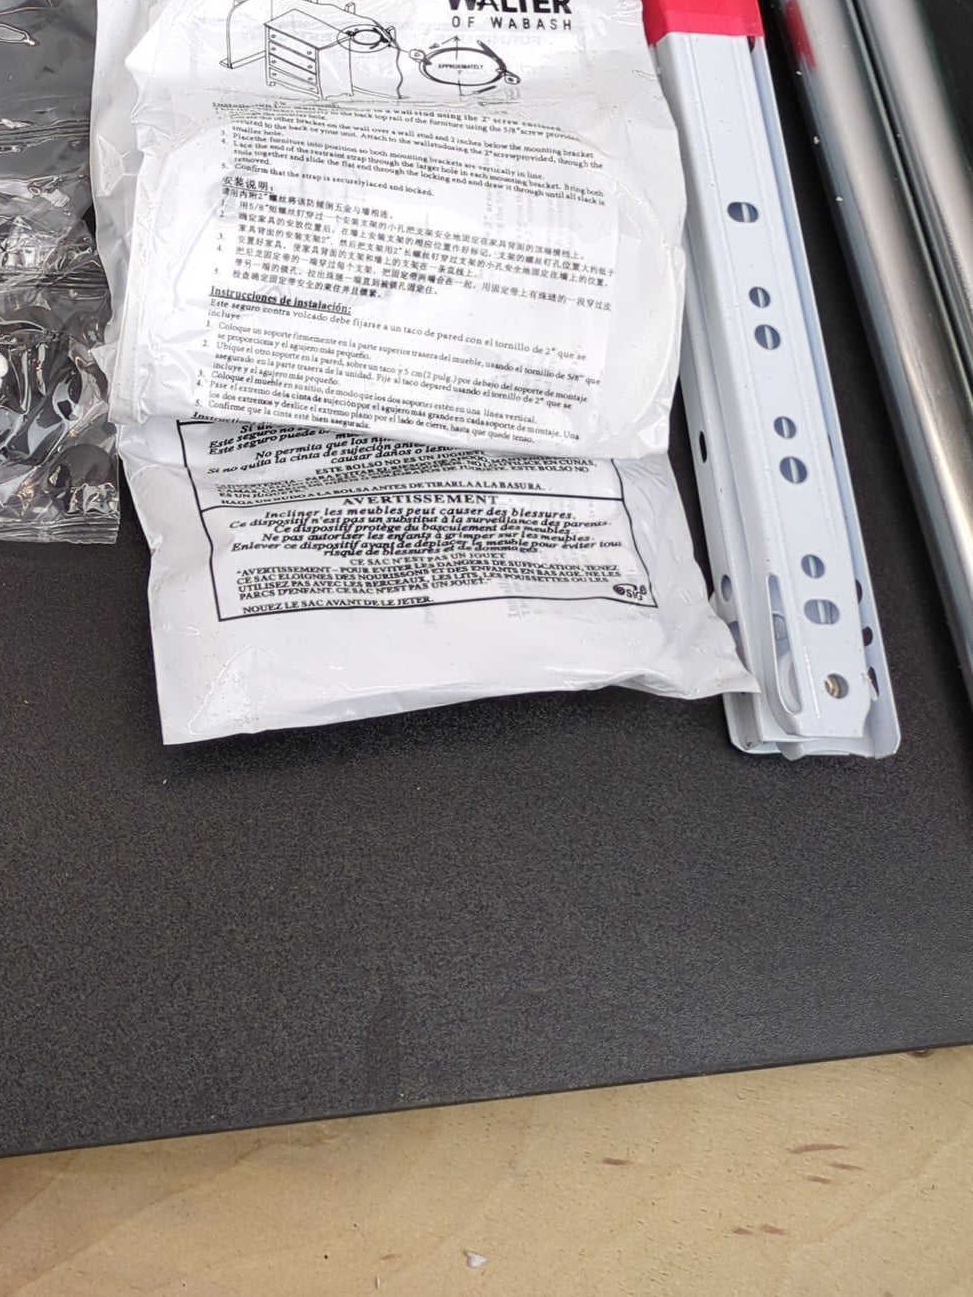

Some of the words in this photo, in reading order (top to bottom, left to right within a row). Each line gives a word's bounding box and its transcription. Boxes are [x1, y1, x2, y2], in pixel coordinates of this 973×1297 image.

[451, 16, 475, 28] OF
[491, 17, 572, 30] WABASH
[296, 145, 309, 154] the
[368, 154, 399, 167] through
[401, 159, 414, 168] the
[369, 147, 387, 157] both
[389, 152, 427, 164] mounting
[269, 166, 285, 176] that
[286, 169, 300, 178] the
[301, 171, 322, 183] strap
[389, 182, 403, 191] and
[210, 285, 276, 304] Instrucciones
[279, 295, 291, 306] de
[210, 297, 229, 308] Este
[231, 302, 260, 313] seguro
[262, 306, 290, 316] contra
[292, 309, 327, 321] volcado
[329, 313, 351, 325] debe
[352, 317, 381, 329] fijarse
[390, 324, 402, 332] un
[403, 324, 422, 335] taco
[424, 327, 435, 337] de
[436, 331, 463, 342] pared
[465, 336, 482, 345] con
[484, 337, 493, 346] el
[494, 338, 530, 351] tornillo
[532, 344, 543, 354] de
[557, 350, 573, 359] que
[255, 449, 271, 458] No
[275, 442, 322, 458] permita
[325, 439, 347, 451] que
[351, 436, 367, 446] los
[343, 494, 498, 505] AVERTISSEMENT
[264, 507, 320, 518] Incliner
[324, 506, 343, 515] les
[347, 505, 403, 515] meubles
[405, 505, 435, 516] peut
[439, 507, 483, 515] causer
[486, 506, 507, 516] des
[261, 533, 279, 541] Ne
[281, 534, 304, 543] pas
[367, 531, 384, 539] les
[239, 588, 275, 600] PARCS
[431, 580, 448, 589] UN
[243, 601, 282, 613] NOUEZ
[284, 599, 299, 609] LE
[301, 597, 323, 607] SAC
